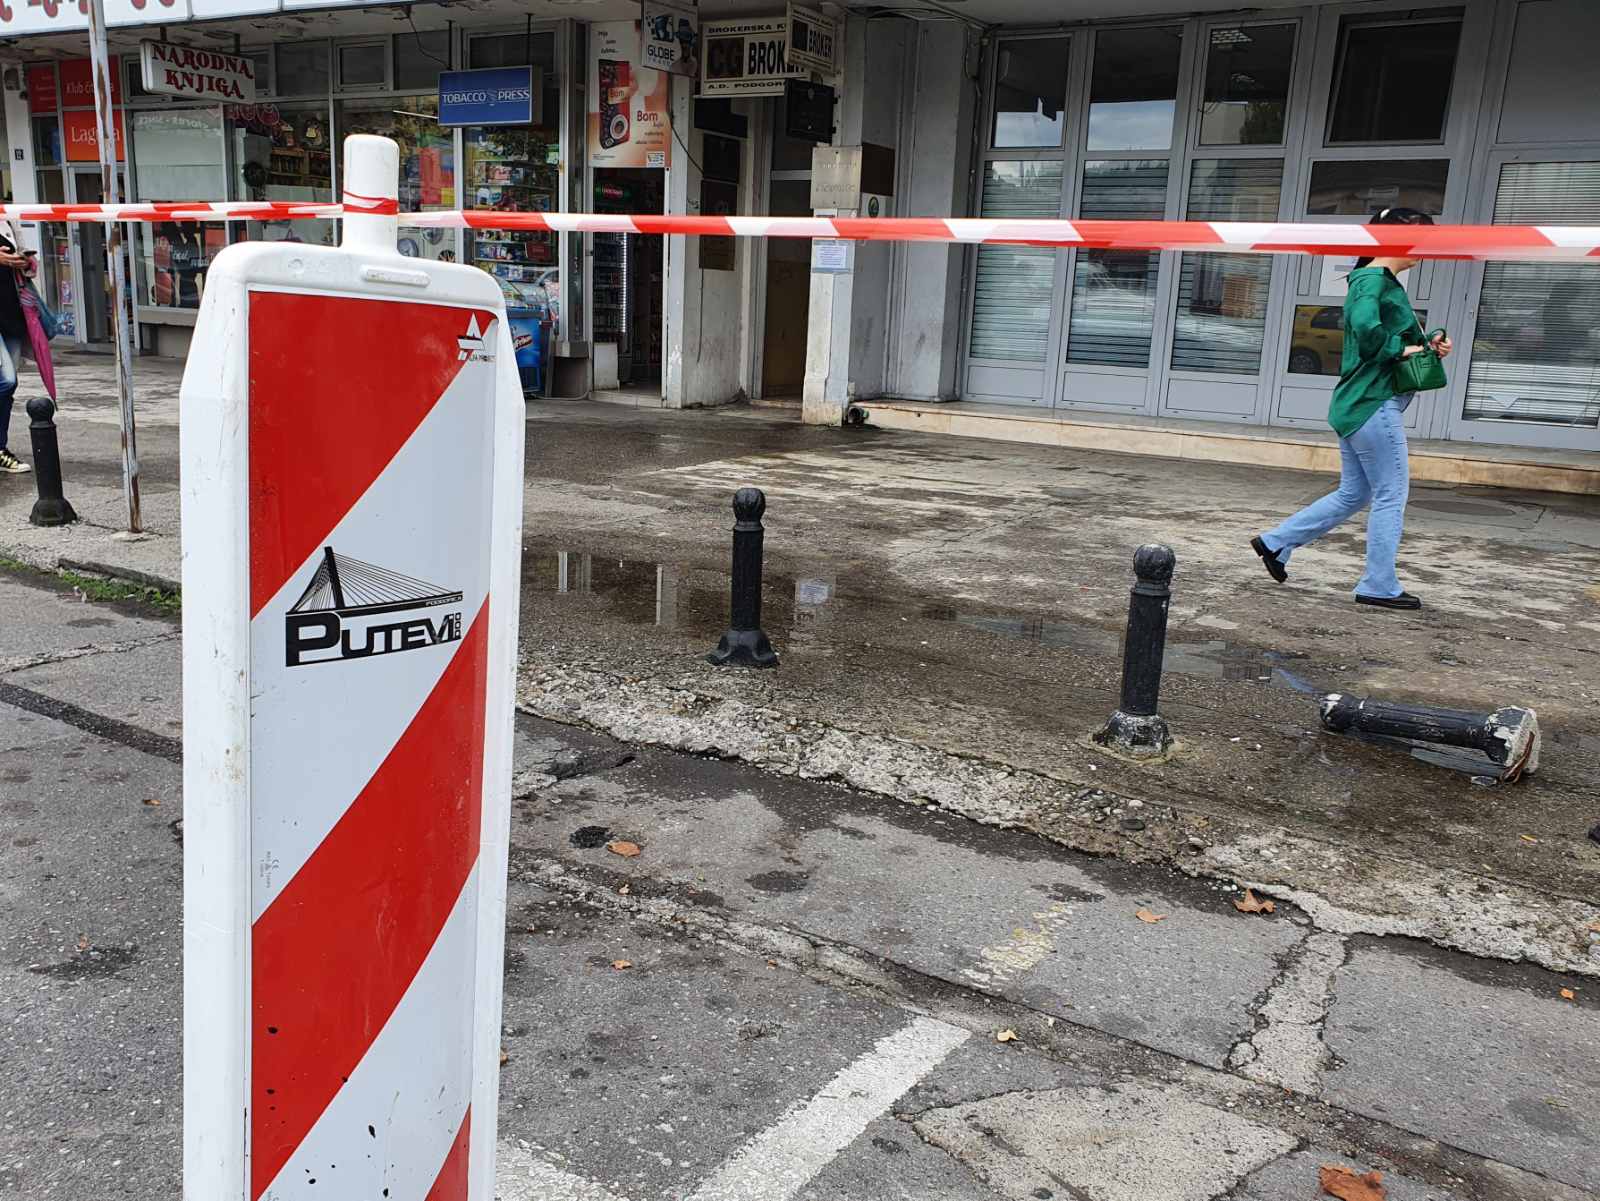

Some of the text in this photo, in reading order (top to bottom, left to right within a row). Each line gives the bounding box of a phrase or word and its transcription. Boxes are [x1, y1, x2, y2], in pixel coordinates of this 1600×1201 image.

[708, 24, 772, 34] BROKERSKA
[648, 44, 675, 61] GLOBE
[809, 30, 833, 58] BROKER
[152, 45, 253, 79] NARODNA
[748, 40, 805, 75] BROK
[165, 69, 244, 99] KNJIGA
[734, 81, 786, 89] PODGOR
[442, 92, 487, 104] TOBACCO
[498, 90, 530, 101] PRESS
[637, 110, 659, 122] Bom
[71, 126, 120, 145] Laga
